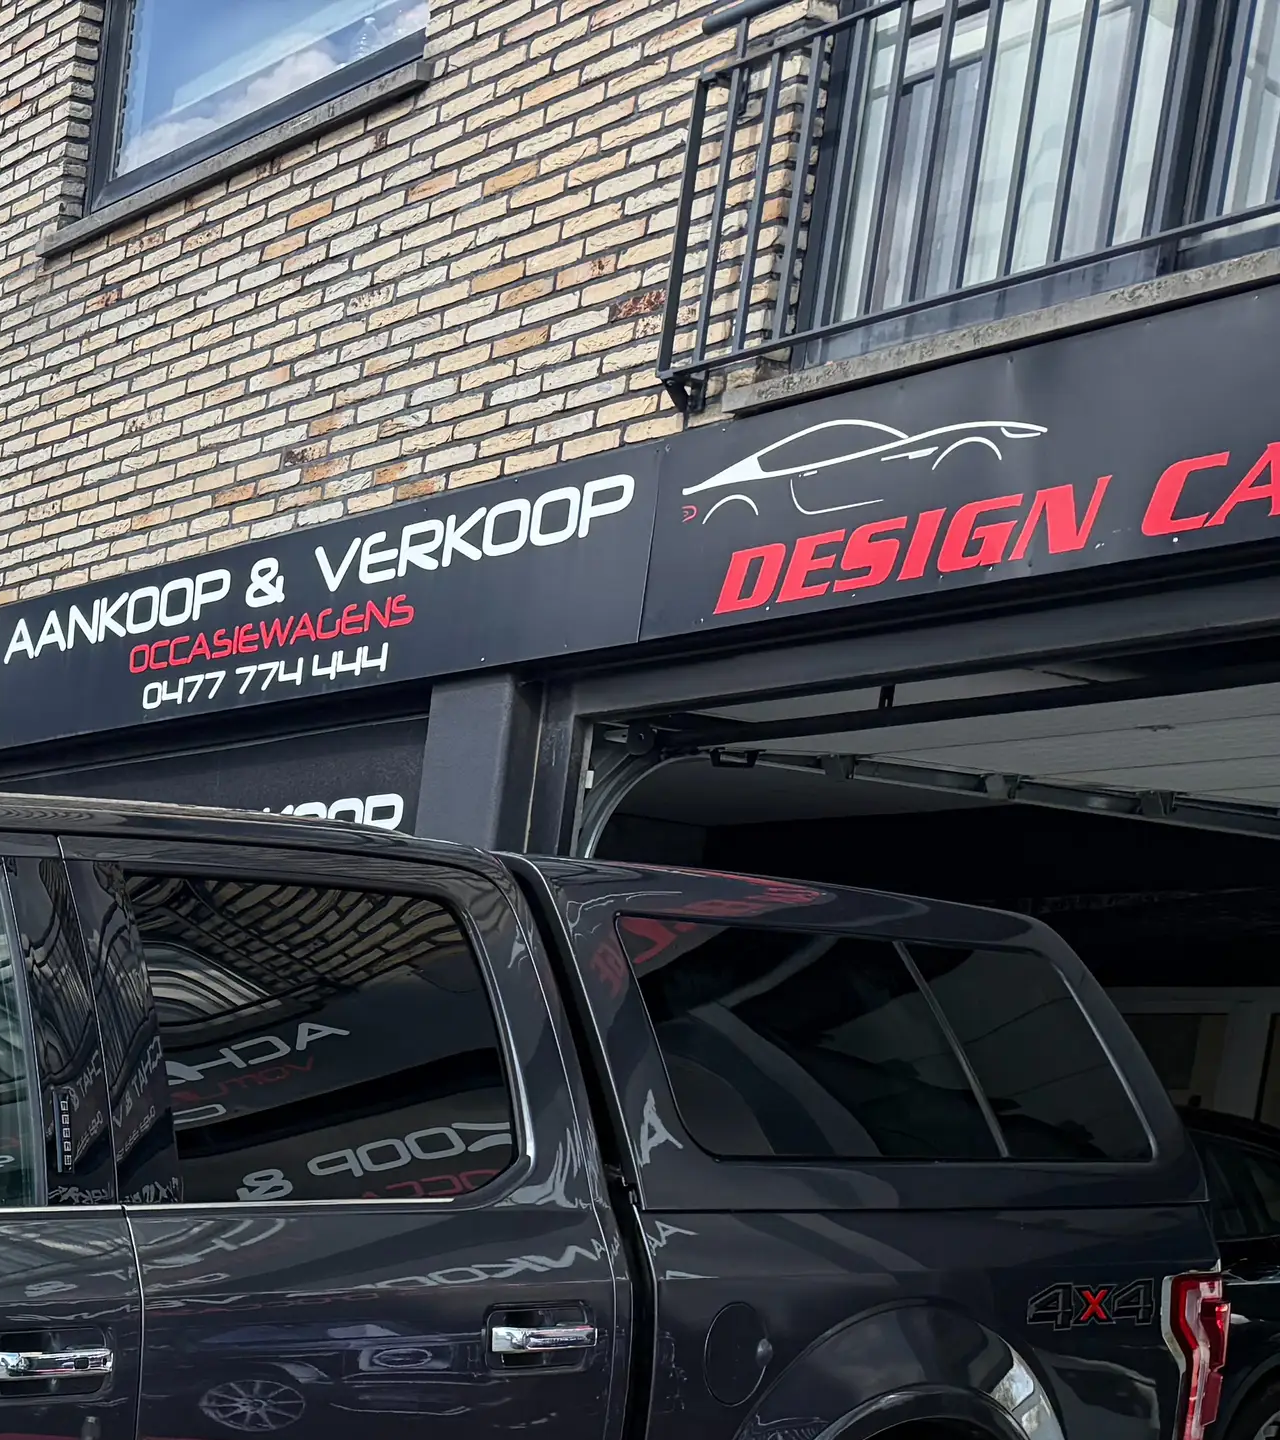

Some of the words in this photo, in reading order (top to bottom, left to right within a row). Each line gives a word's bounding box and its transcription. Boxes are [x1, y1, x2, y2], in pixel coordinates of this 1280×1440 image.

[3, 568, 231, 665] AANKOOP
[245, 557, 285, 608] &
[314, 473, 636, 592] VERKOOP
[713, 475, 1112, 615] DESIGN
[129, 594, 416, 674] OCCASIEWAGENS
[142, 670, 226, 710] 0477
[235, 657, 304, 694] 774
[312, 642, 389, 681] 444
